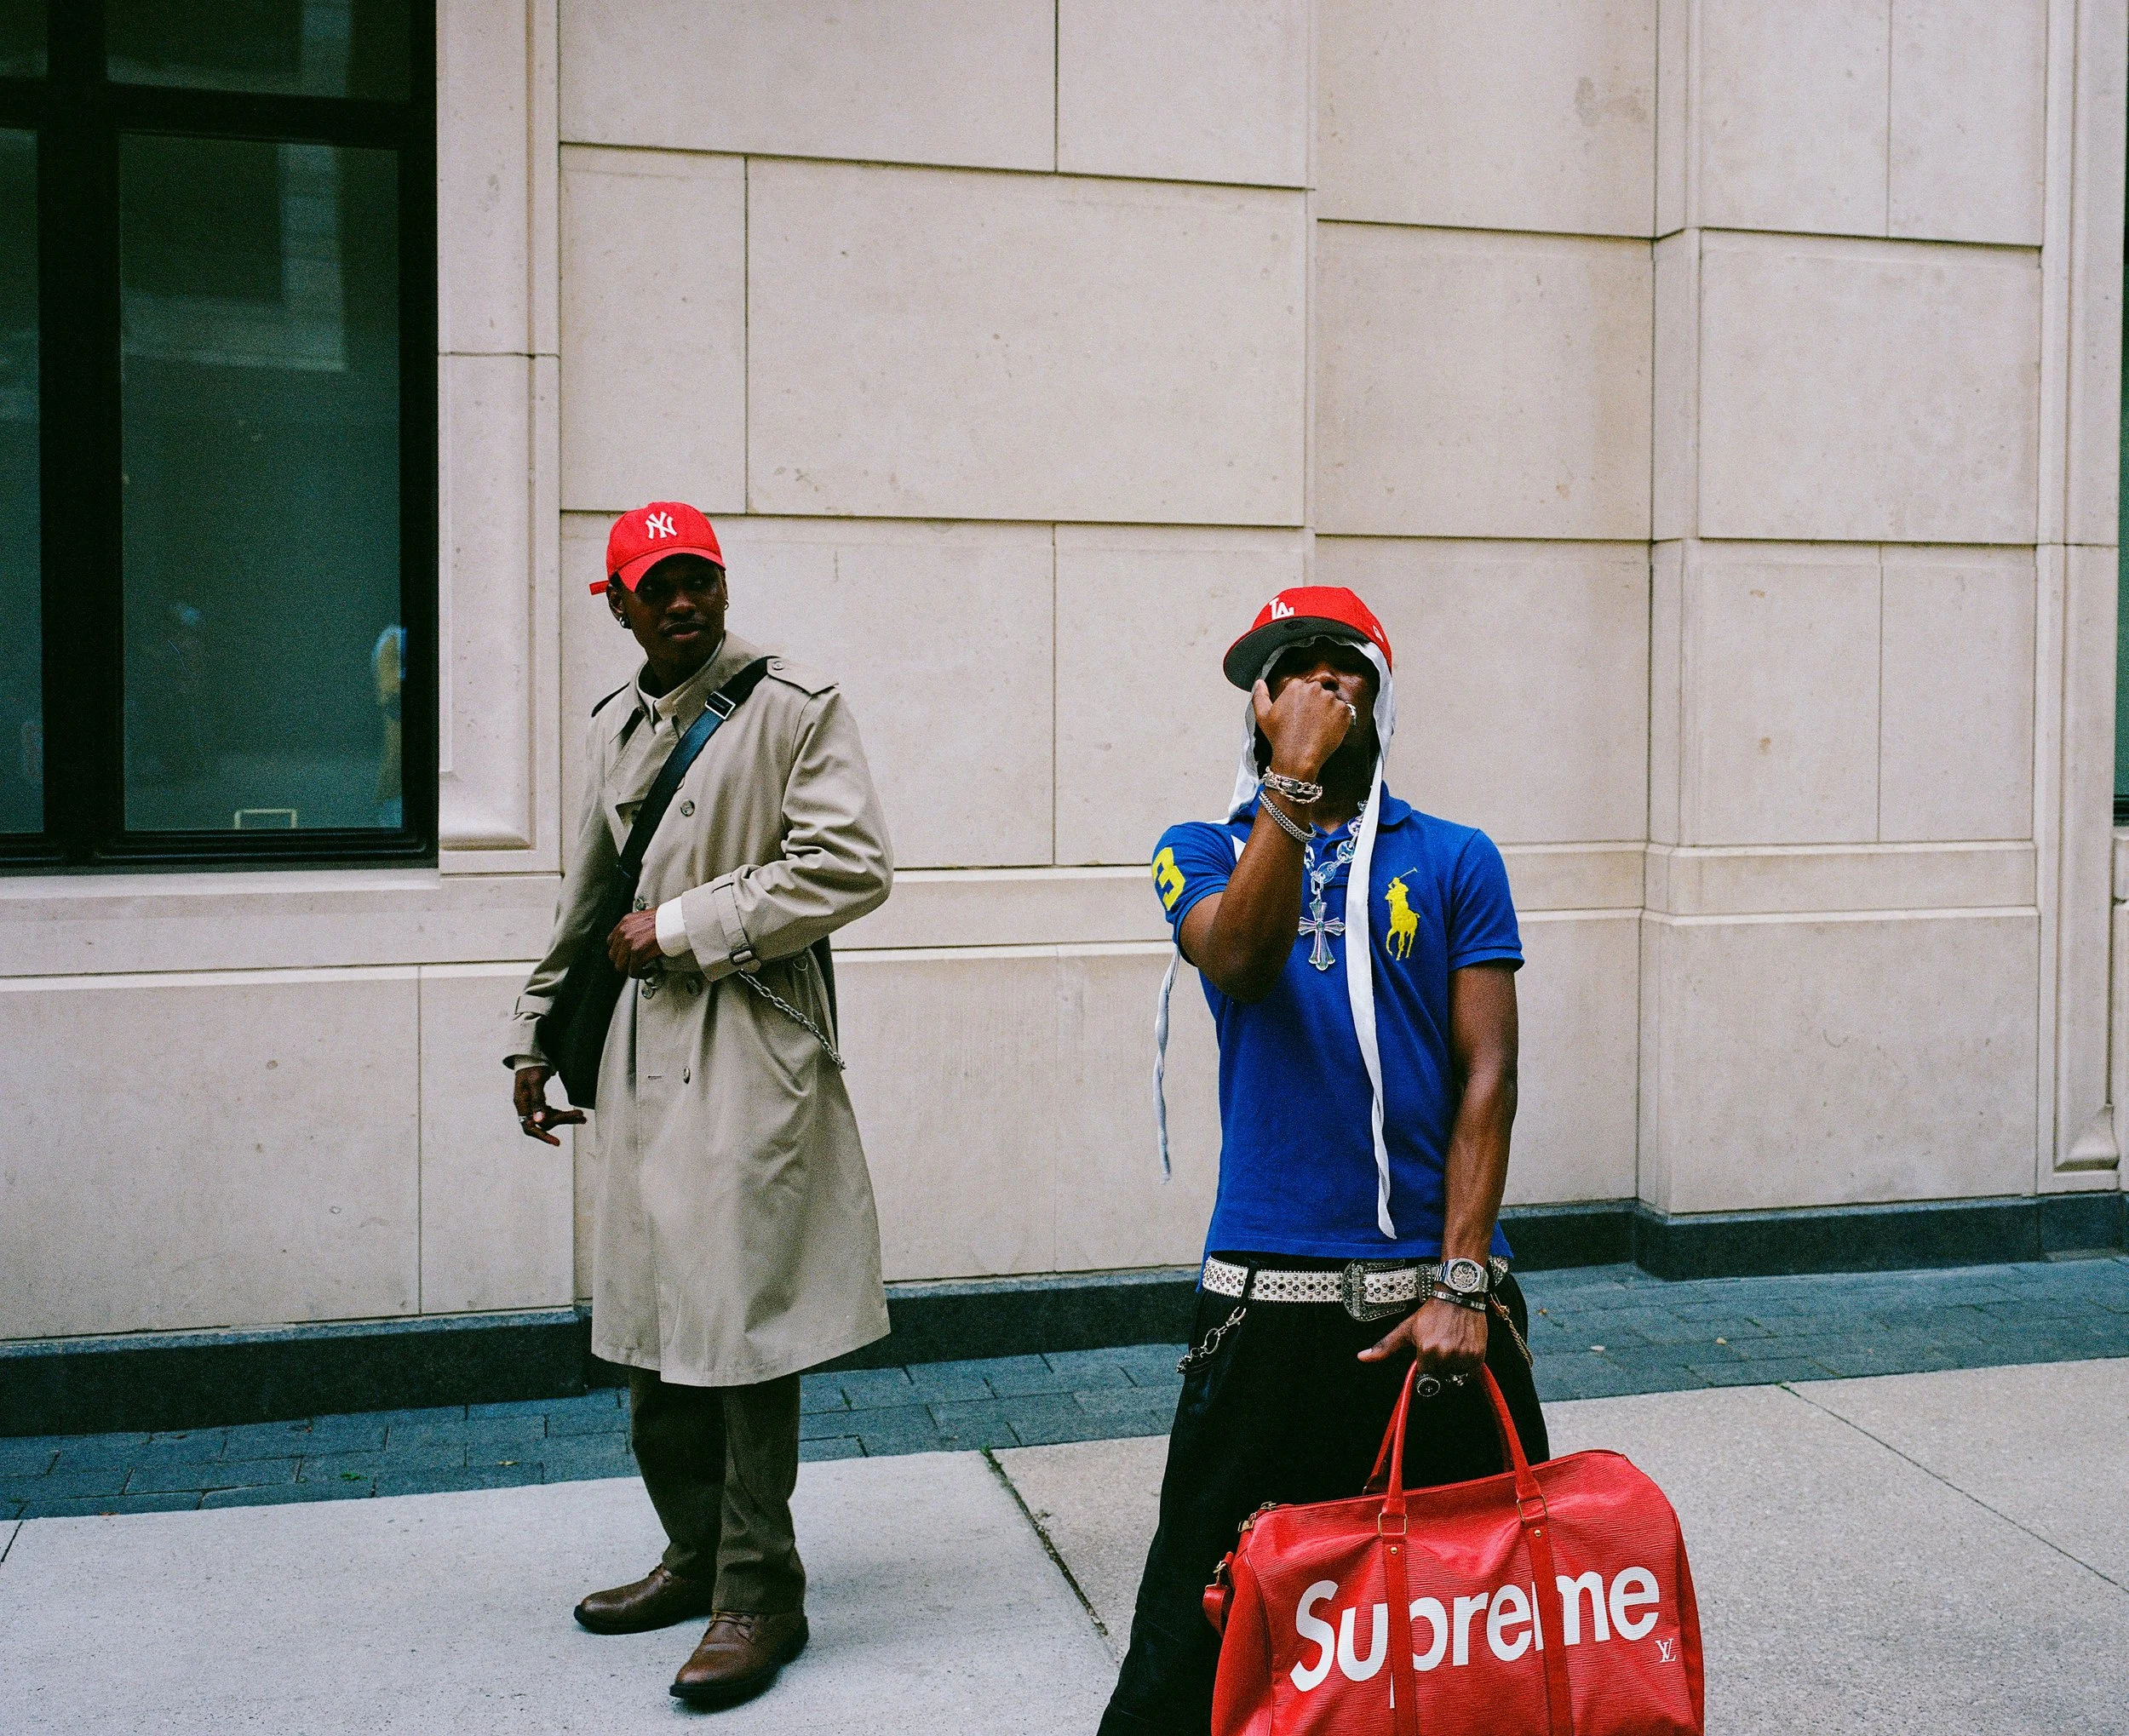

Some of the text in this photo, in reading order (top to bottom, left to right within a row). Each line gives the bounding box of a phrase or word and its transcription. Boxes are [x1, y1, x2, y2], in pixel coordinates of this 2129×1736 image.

[646, 511, 678, 540] NY
[1269, 597, 1294, 621] LA
[1151, 847, 1186, 911] 3
